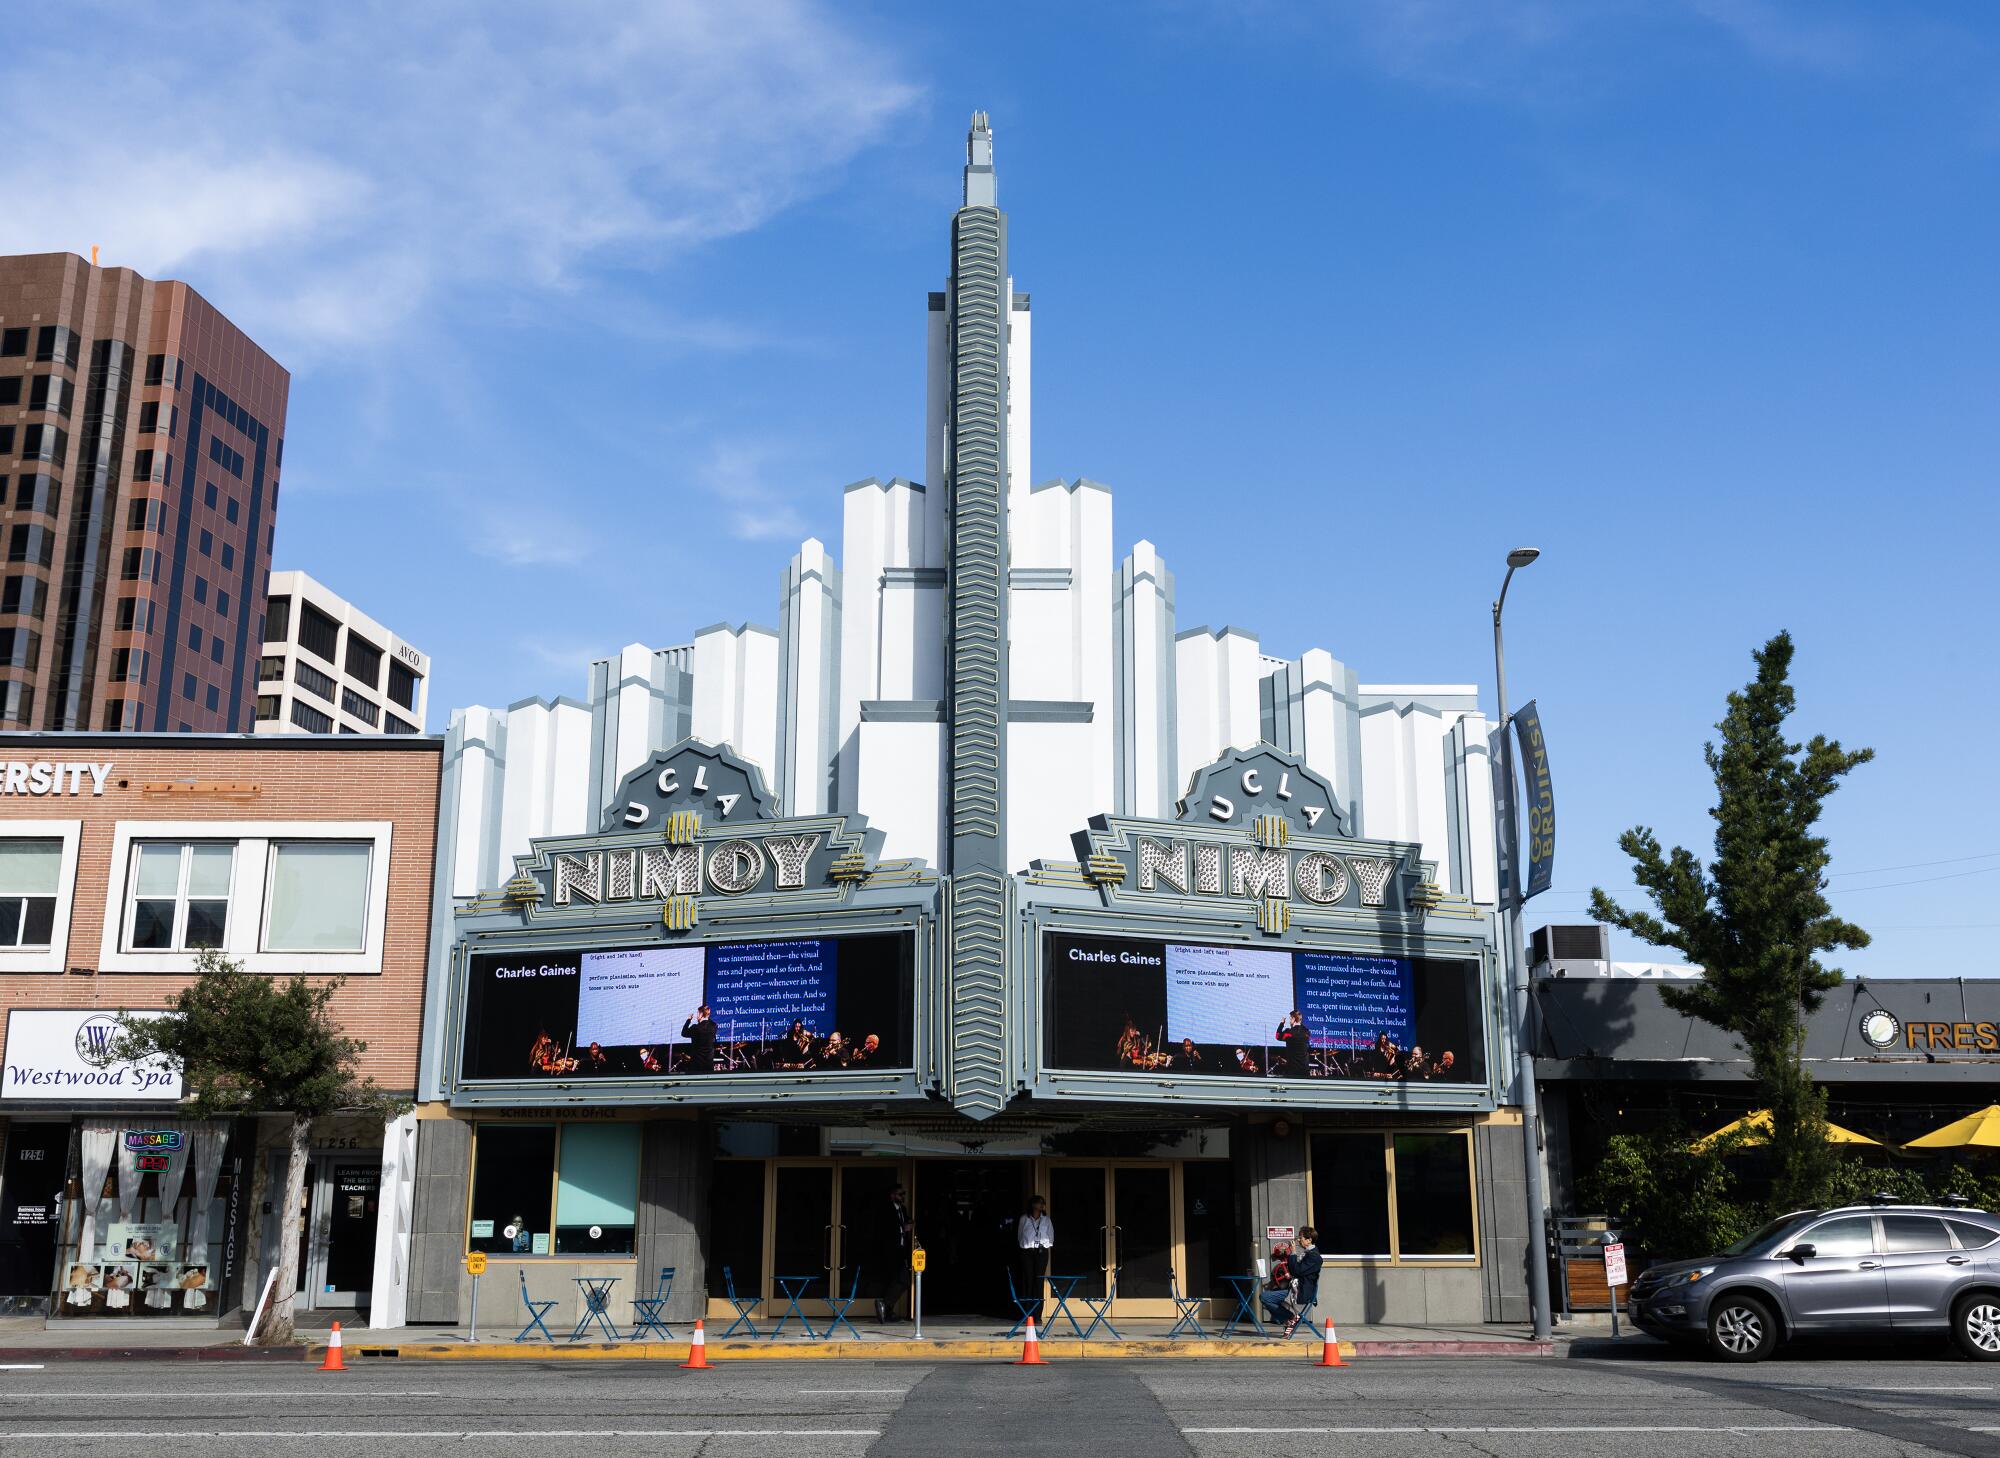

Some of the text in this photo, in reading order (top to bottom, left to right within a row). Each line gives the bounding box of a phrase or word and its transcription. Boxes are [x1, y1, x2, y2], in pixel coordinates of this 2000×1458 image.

[399, 645, 420, 666] AVCO
[1527, 717, 1553, 857] BRUINS!
[625, 766, 741, 824] UCLA
[1210, 769, 1325, 829] UCLA
[1530, 806, 1542, 864] GO
[553, 834, 821, 908] NIMOY
[1138, 836, 1399, 908] NIMOY
[731, 952, 765, 962] intermixed
[800, 950, 818, 958] visual
[1069, 948, 1161, 966] Charles Gaines
[495, 963, 577, 979] Charles Gaines
[744, 968, 764, 976] poetry
[766, 965, 778, 973] and
[788, 964, 806, 972] forth.
[808, 962, 822, 971] And
[1318, 963, 1349, 972] intermixed
[1381, 967, 1397, 975] visual
[809, 976, 819, 984] the
[1318, 976, 1329, 984] and
[1330, 979, 1350, 987] poetry
[1370, 979, 1386, 987] forth.
[1388, 980, 1400, 988] And
[732, 995, 750, 1004] spent
[767, 991, 781, 999] with
[783, 991, 801, 999] them.
[803, 990, 818, 998] And
[716, 1007, 733, 1016] when
[735, 1006, 765, 1014] Maciunas
[792, 1004, 800, 1012] he
[801, 1003, 825, 1012] latched
[1308, 1014, 1324, 1022] when
[1325, 1015, 1353, 1023] Maciunas
[1385, 1018, 1406, 1026] latched
[1905, 1022, 2000, 1050] FRES
[8, 1065, 173, 1091] Westwood Spa
[500, 1108, 616, 1118] SCHREYER BOX OFFICE
[128, 1134, 176, 1146] MASSAGE
[318, 1137, 357, 1150] 1256
[21, 1150, 44, 1160] 1254
[136, 1156, 169, 1170] OPEN
[225, 1158, 242, 1278] MASSAGE
